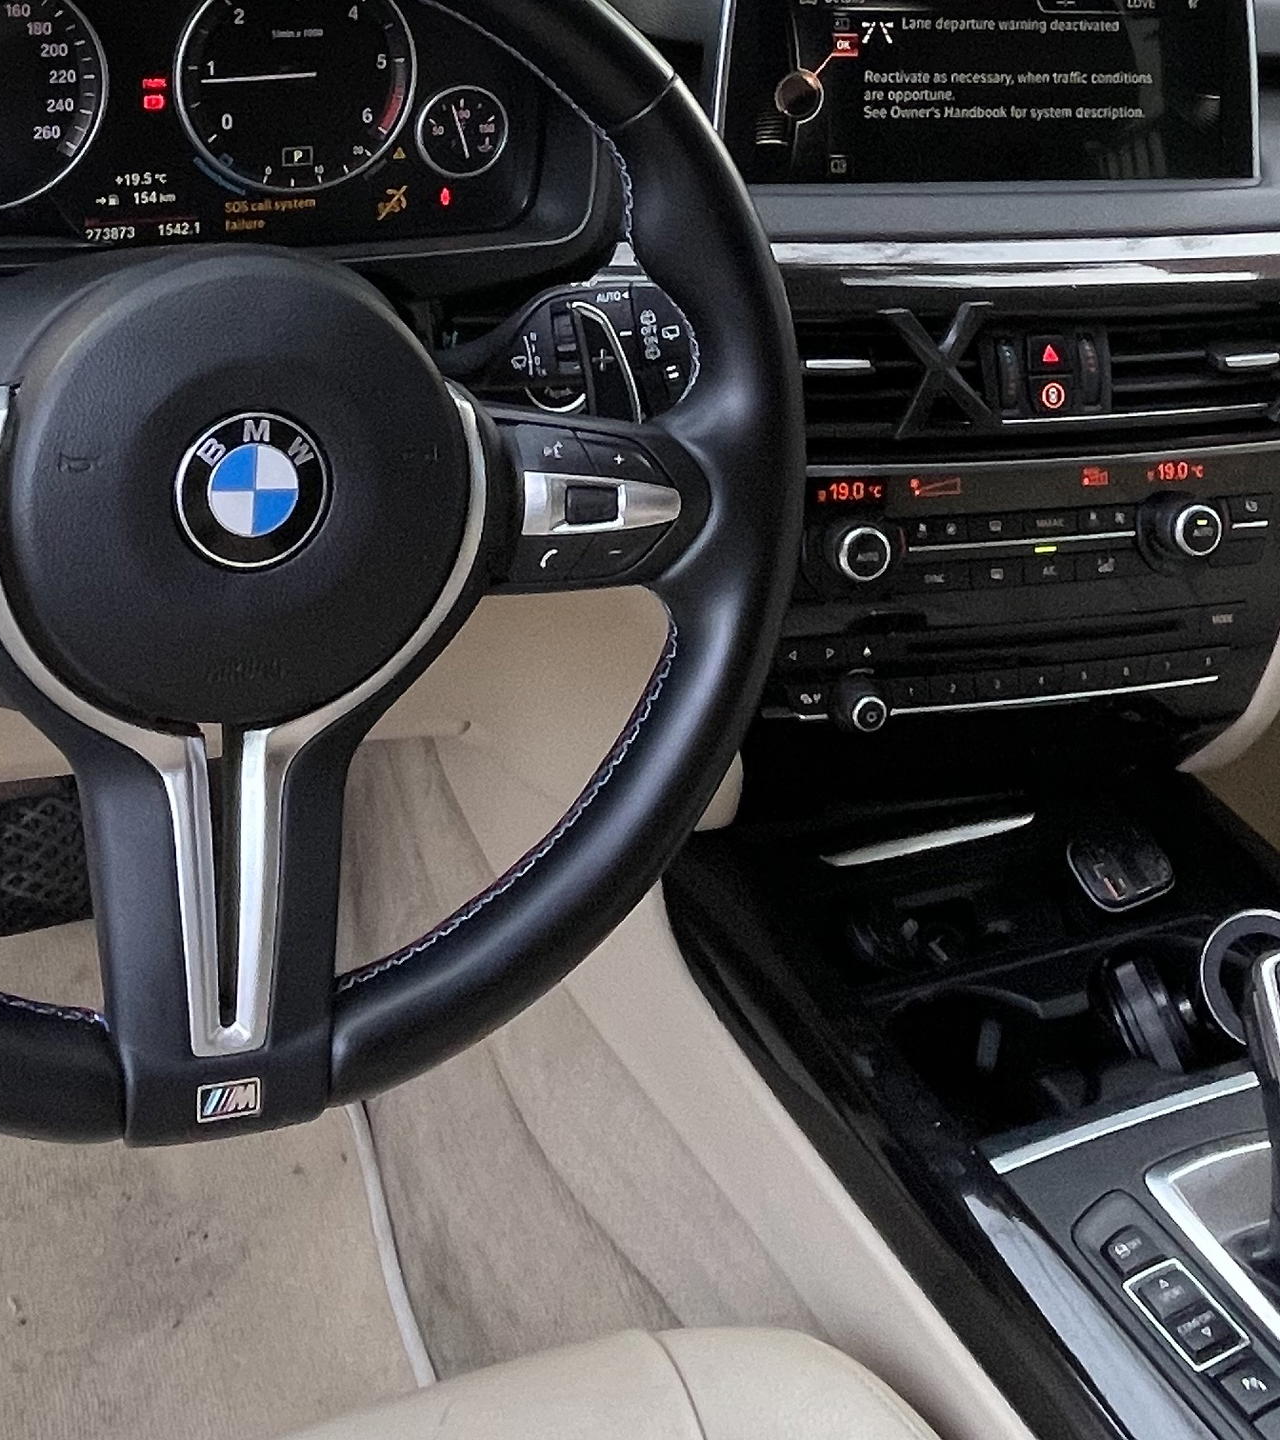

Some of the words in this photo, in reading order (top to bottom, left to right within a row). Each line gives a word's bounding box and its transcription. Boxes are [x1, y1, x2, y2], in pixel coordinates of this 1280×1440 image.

[6, 4, 31, 18] 160
[233, 8, 245, 26] 2
[348, 5, 358, 21] 4
[26, 22, 52, 36] 180
[902, 17, 931, 30] Lane
[936, 17, 995, 32] departure
[999, 19, 1047, 34] warning
[1050, 19, 1120, 32] deactivated
[40, 44, 68, 58] 200
[836, 40, 851, 50] OK
[207, 61, 216, 75] 1
[376, 54, 387, 70] 5
[49, 69, 76, 84] 220
[864, 70, 930, 84] Reactivate
[933, 73, 948, 84] as
[951, 72, 1015, 86] necessary,
[1017, 71, 1050, 84] when
[1053, 71, 1088, 84] traffic
[1091, 71, 1153, 85] conditions
[864, 90, 884, 101] are
[888, 89, 955, 103] opportune.
[47, 98, 74, 113] 240
[362, 108, 373, 124] 6
[864, 106, 887, 119] See
[890, 106, 941, 119] Owner's
[944, 106, 1008, 119] Handbook
[1010, 106, 1028, 120] for
[1030, 108, 1072, 121] system
[1075, 106, 1146, 121] description.
[221, 113, 233, 130] 0
[33, 125, 61, 140] 260
[115, 172, 152, 186] +19.5
[133, 191, 157, 205] 154
[159, 192, 176, 203] km
[224, 201, 249, 213] SOS
[251, 200, 272, 212] call
[274, 197, 316, 211] system
[158, 221, 201, 236] 1542.1
[225, 218, 266, 232] failure
[596, 291, 620, 303] AUTO
[196, 419, 315, 467] BMW
[1158, 462, 1189, 480] 19.0
[830, 482, 865, 500] 19.0
